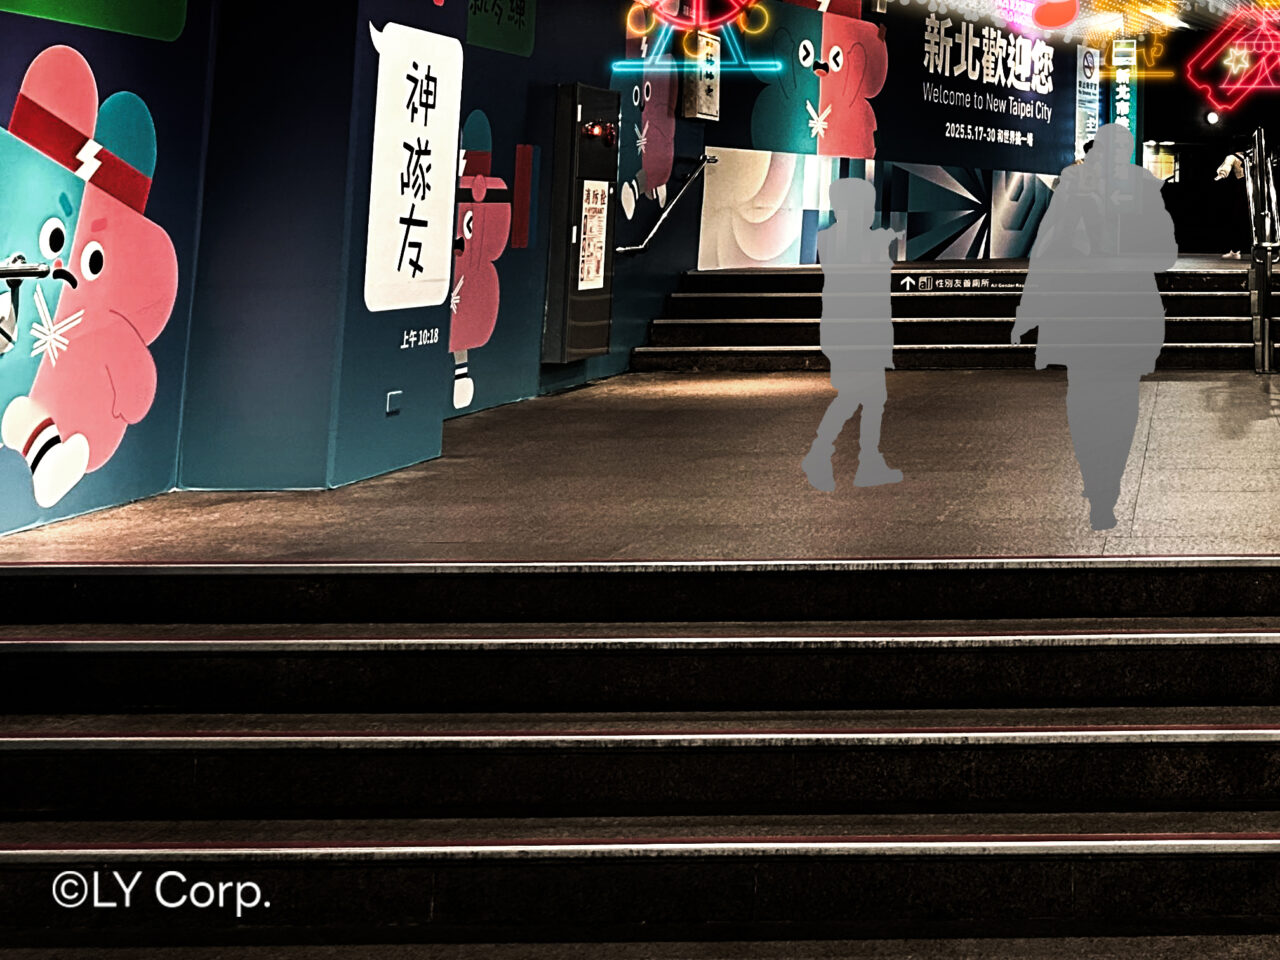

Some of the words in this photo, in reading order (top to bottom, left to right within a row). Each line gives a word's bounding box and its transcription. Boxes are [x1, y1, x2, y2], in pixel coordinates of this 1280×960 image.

[923, 12, 1055, 95] 新北歡迎您
[922, 81, 971, 108] Welcome
[974, 91, 984, 110] to
[986, 93, 1007, 113] New
[1008, 96, 1034, 119] Taipei
[1035, 100, 1053, 124] City
[945, 121, 996, 143] 2025.5.17-30
[397, 61, 438, 278] 神隊友
[935, 278, 990, 289] 性別友善廁所
[400, 329, 418, 349] 上午
[417, 327, 439, 346] 10:18
